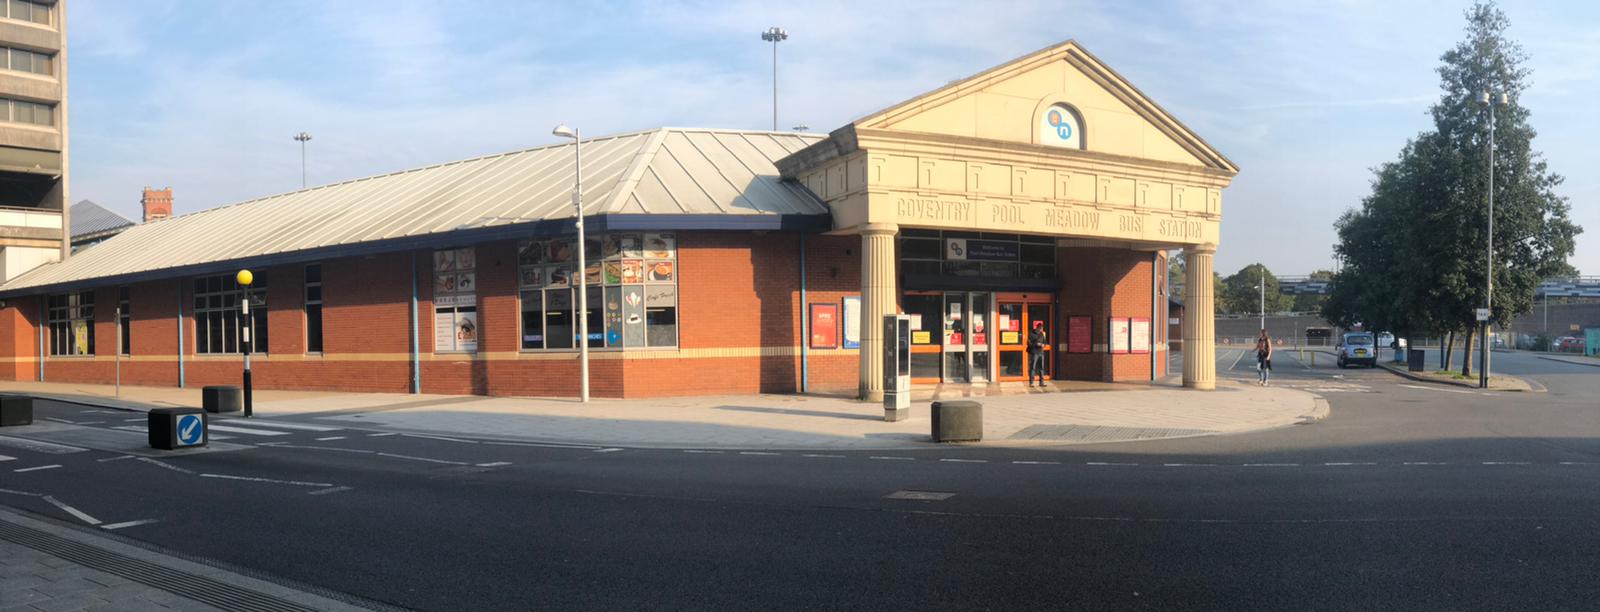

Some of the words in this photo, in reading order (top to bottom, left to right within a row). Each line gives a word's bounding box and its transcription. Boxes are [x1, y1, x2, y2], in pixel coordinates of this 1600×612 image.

[897, 198, 971, 222] COVENTRY
[991, 203, 1025, 225] POOL
[1045, 208, 1100, 231] MEADOW
[1118, 215, 1142, 233] BUS
[1159, 218, 1202, 239] STATION
